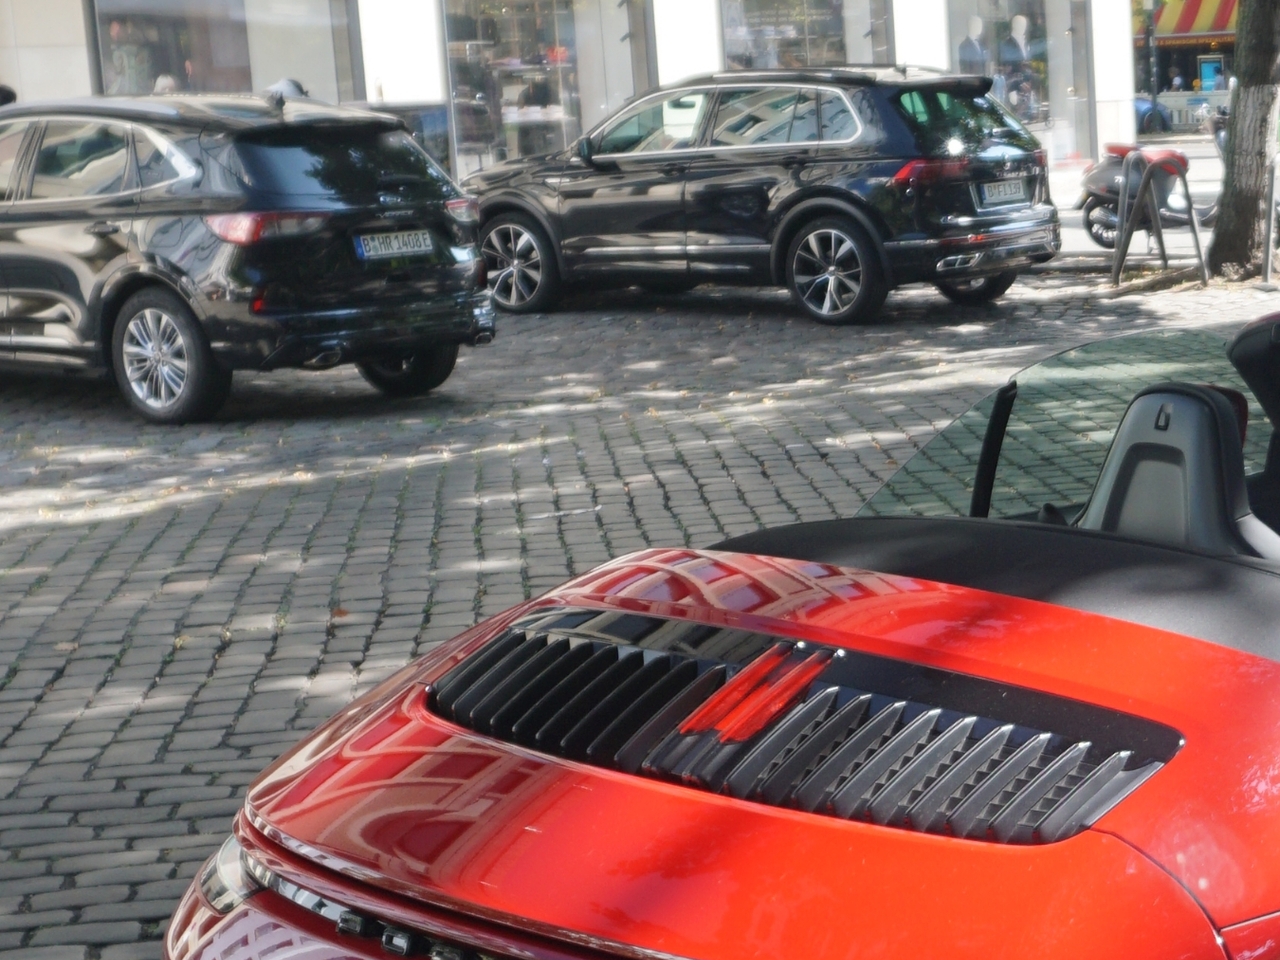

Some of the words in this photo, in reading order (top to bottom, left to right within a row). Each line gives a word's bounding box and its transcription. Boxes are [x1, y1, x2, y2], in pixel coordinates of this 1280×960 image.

[987, 185, 994, 198] B
[362, 236, 372, 254] B
[376, 234, 394, 252] HR
